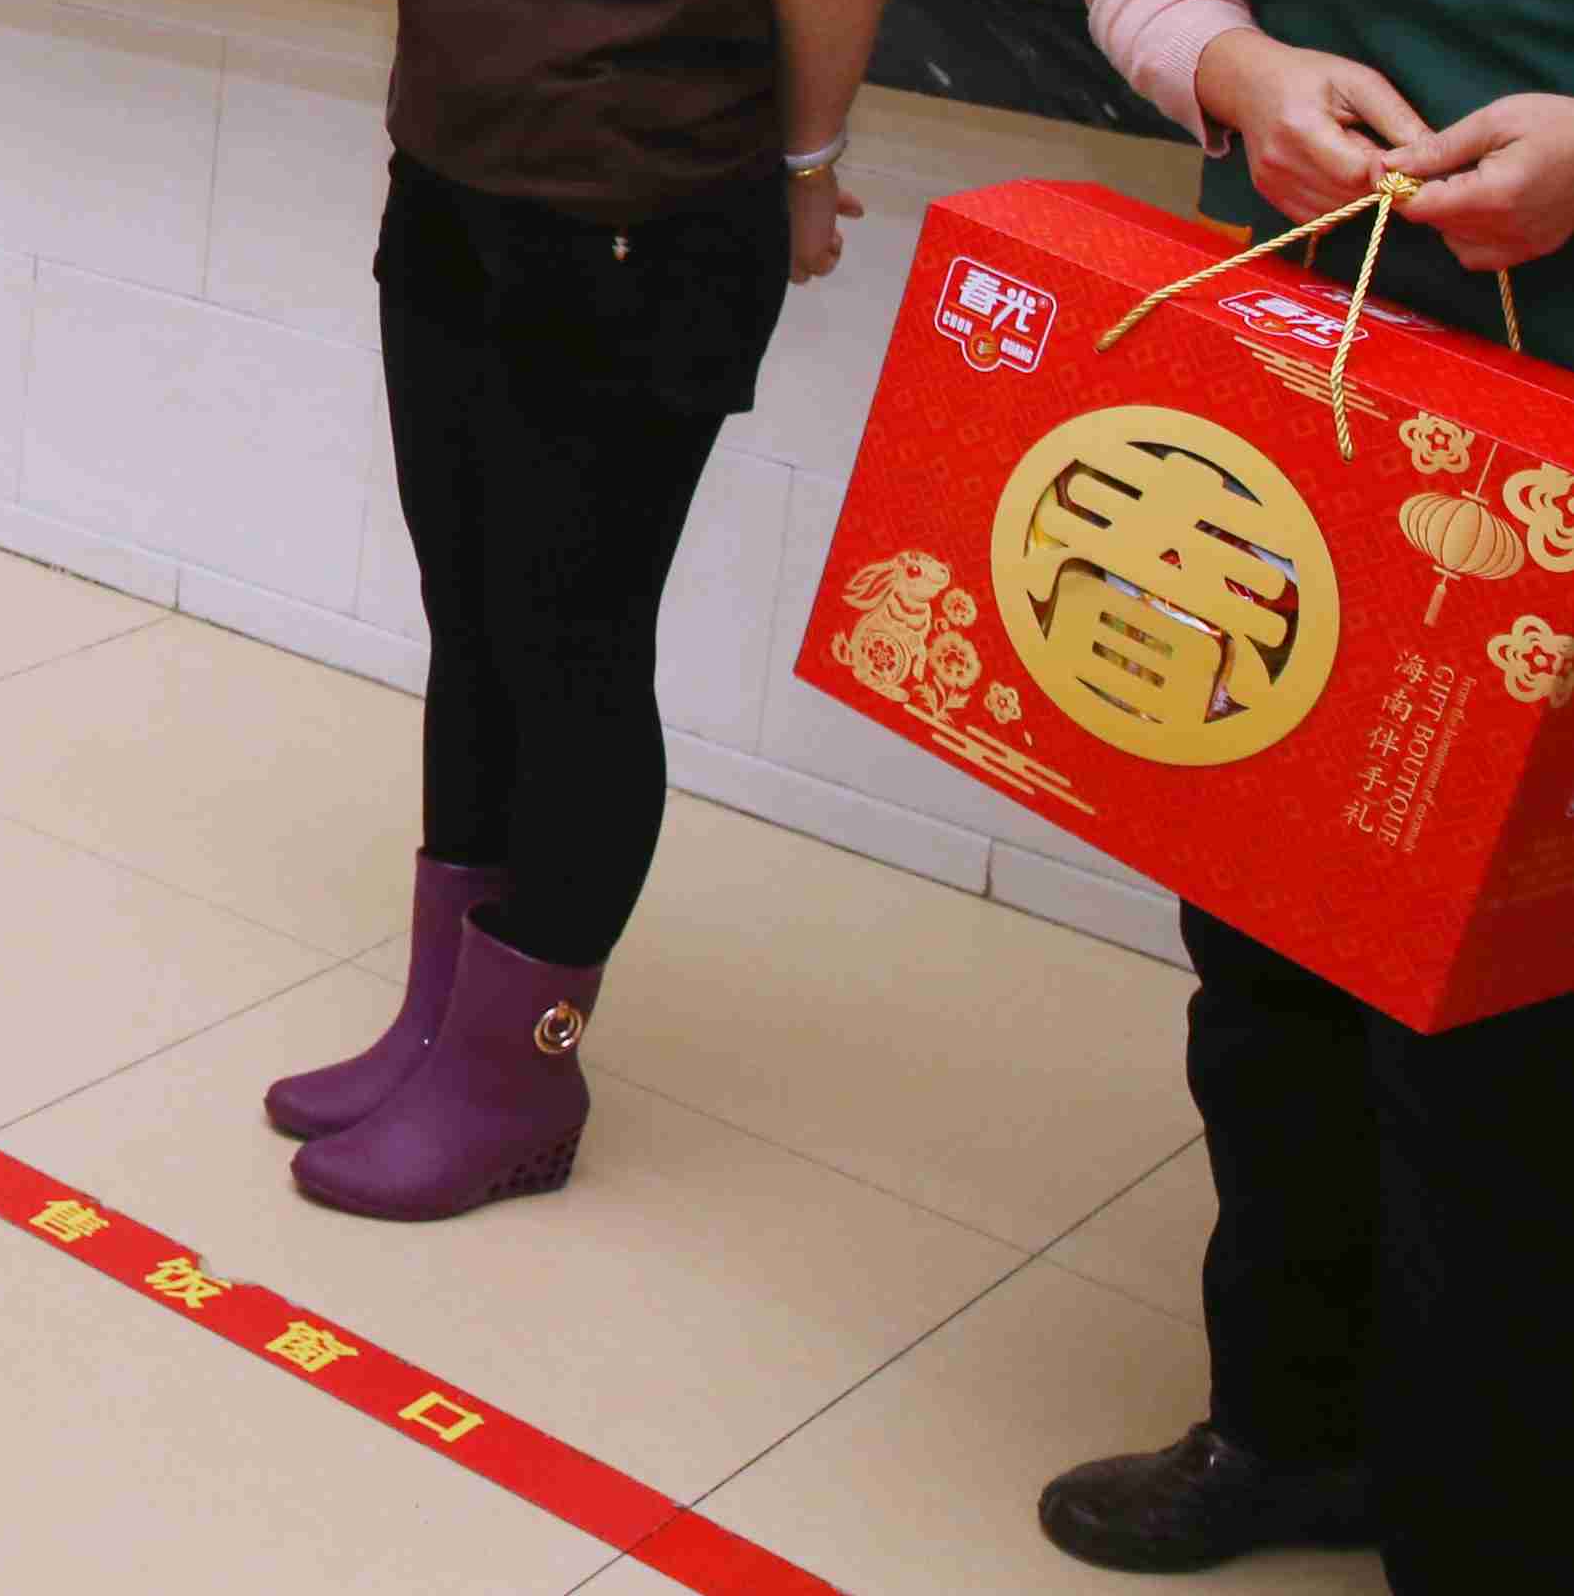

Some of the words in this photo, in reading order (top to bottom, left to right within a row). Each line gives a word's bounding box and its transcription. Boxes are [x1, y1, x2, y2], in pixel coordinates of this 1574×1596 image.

[959, 269, 1037, 333] 春光
[1421, 665, 1456, 723] GIFT
[1376, 723, 1436, 847] BOUTIQUE
[28, 1199, 484, 1443] 售饭窗口
